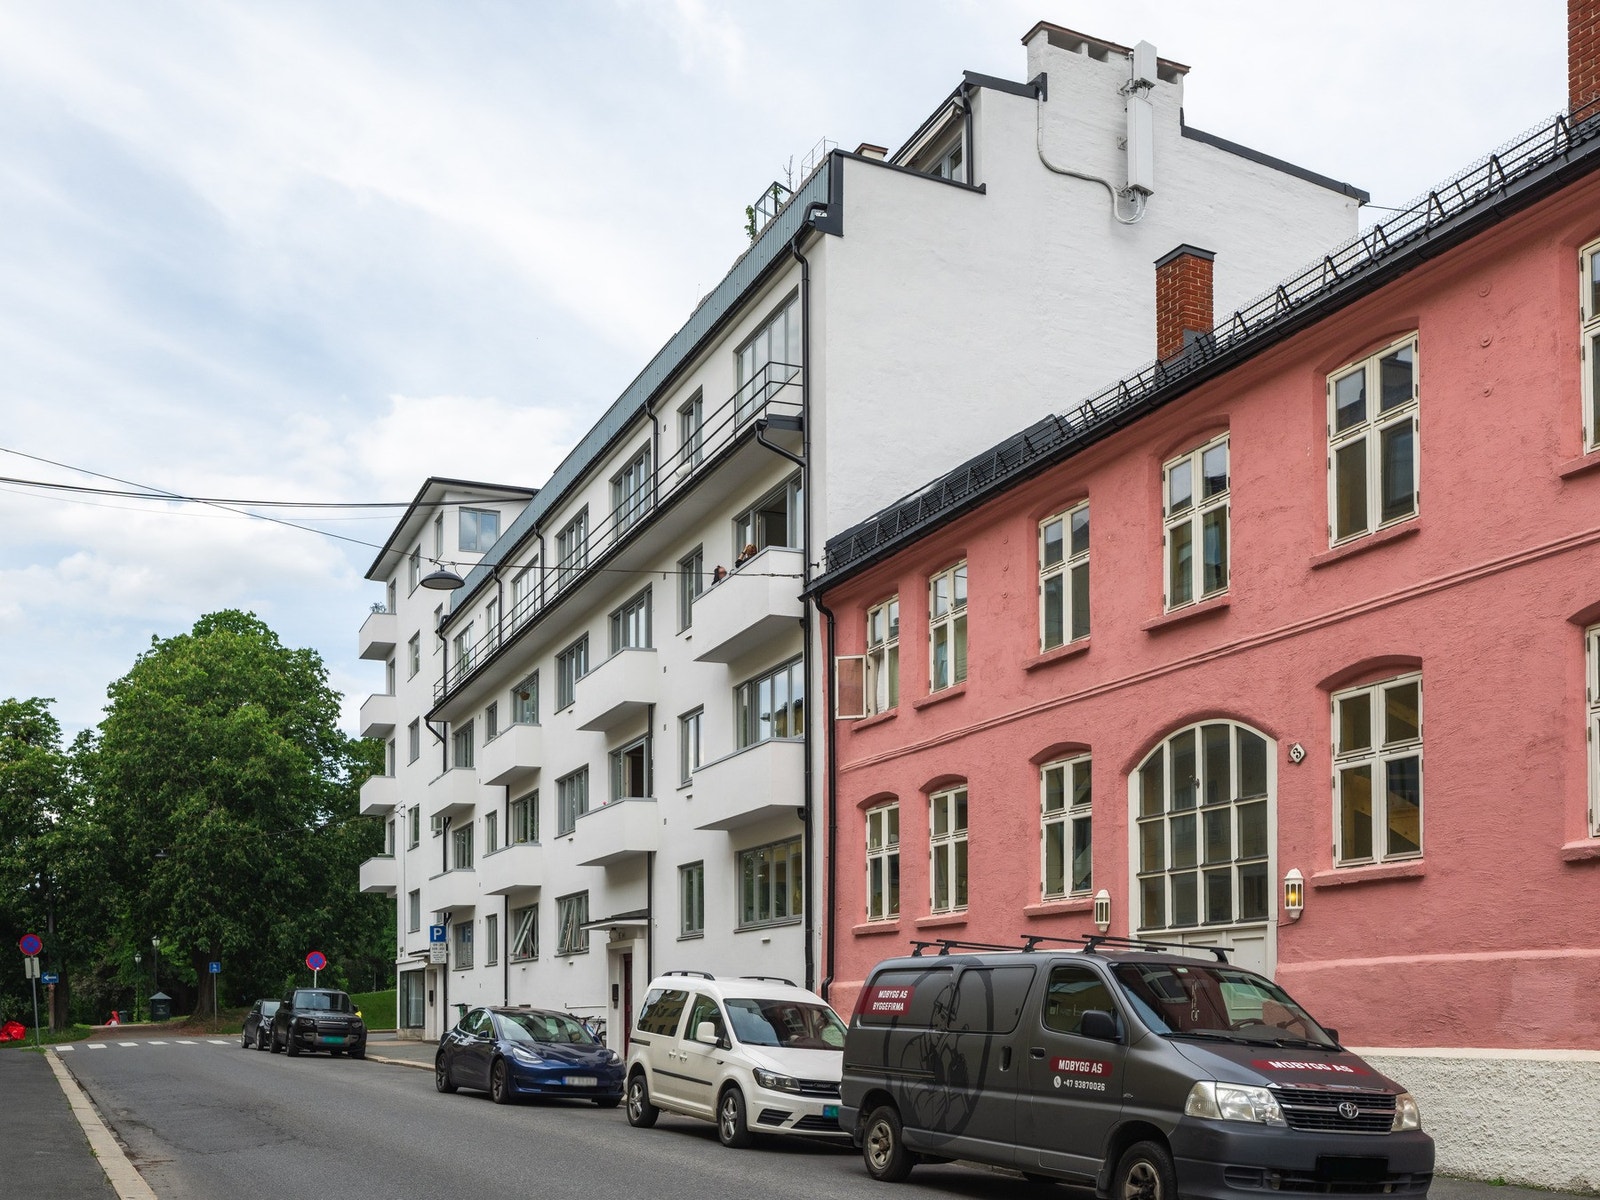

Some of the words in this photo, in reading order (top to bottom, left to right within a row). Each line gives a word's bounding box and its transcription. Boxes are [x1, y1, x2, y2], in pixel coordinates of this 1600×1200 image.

[1293, 747, 1302, 759] 3
[433, 928, 443, 940] P
[878, 990, 900, 999] MOBYGG
[899, 990, 908, 999] AS
[872, 1002, 904, 1011] BYGGEFIRMA
[1058, 1059, 1090, 1072] MOBYGG
[1091, 1062, 1103, 1074] AS
[1268, 1061, 1332, 1071] MOBYGG
[1332, 1064, 1354, 1073] AS
[1063, 1079, 1074, 1088] +47
[1074, 1080, 1106, 1092] 93870026
